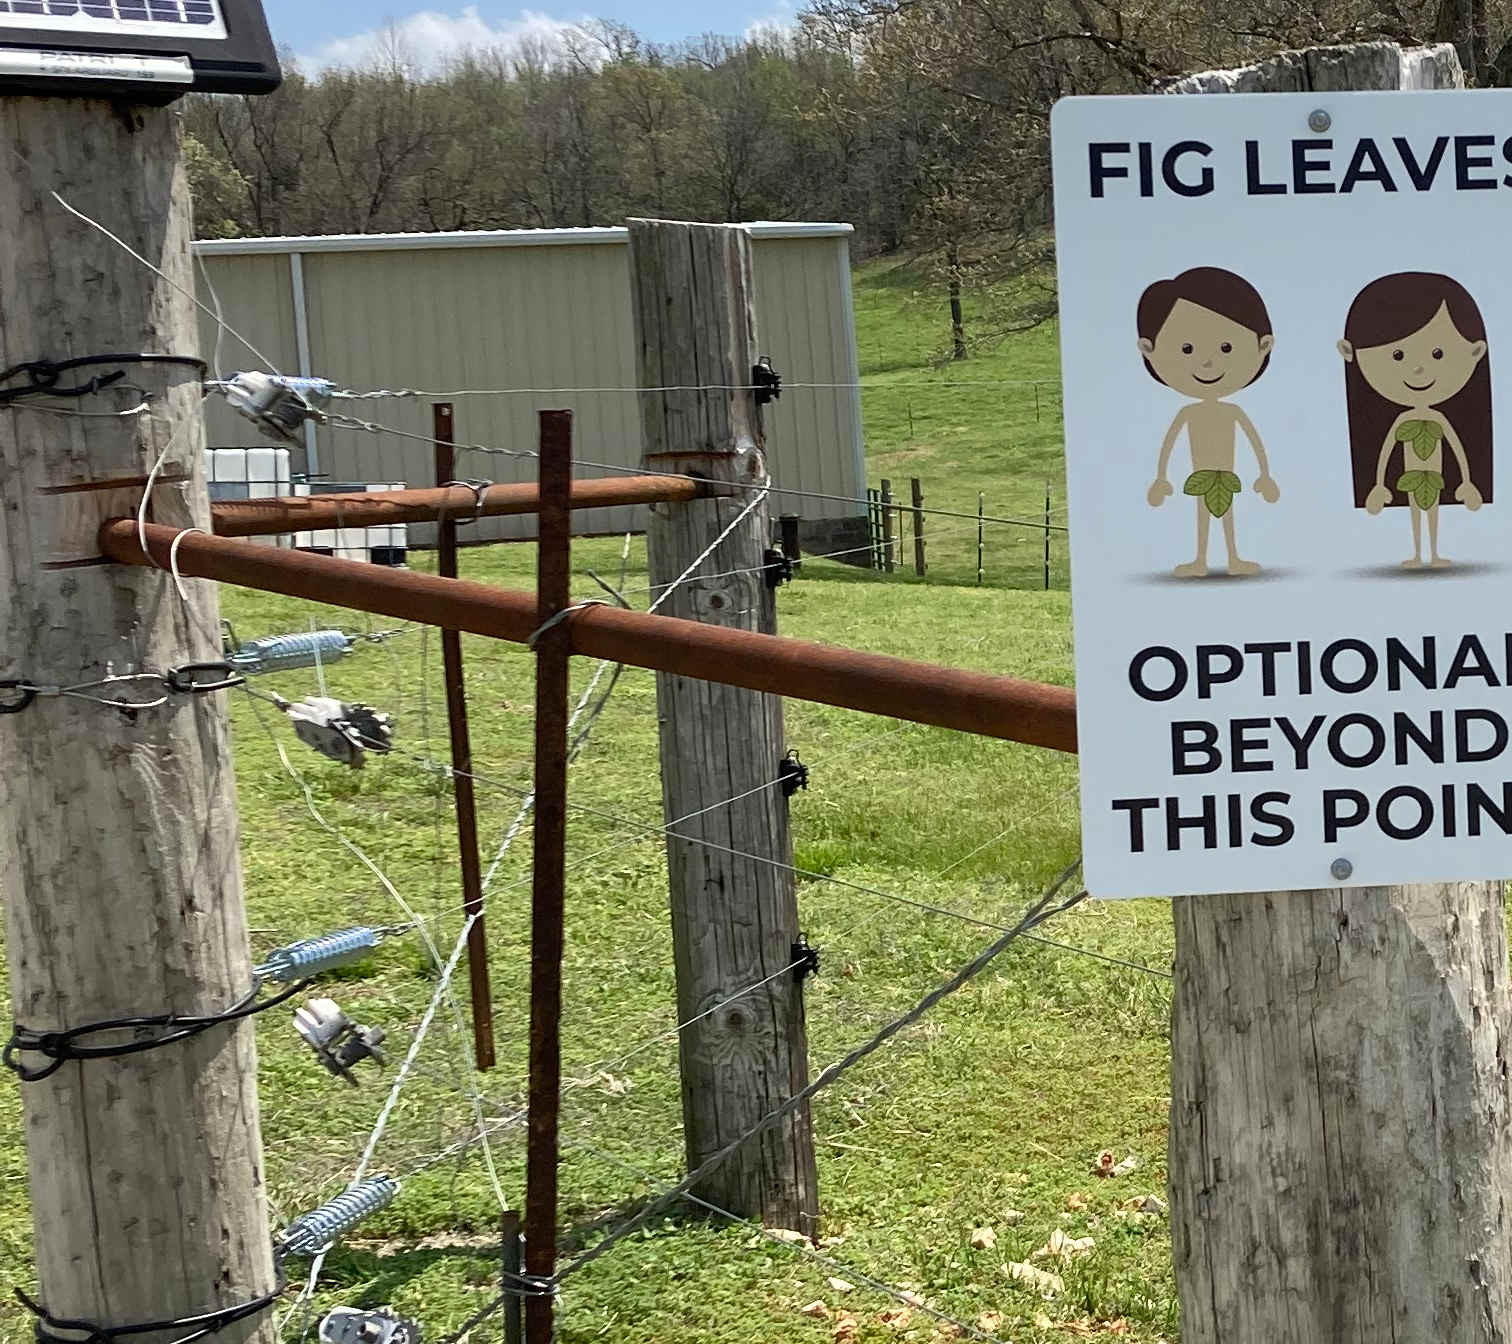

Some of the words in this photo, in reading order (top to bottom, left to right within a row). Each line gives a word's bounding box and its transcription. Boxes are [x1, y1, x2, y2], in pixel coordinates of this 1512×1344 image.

[1088, 141, 1215, 198] FIG
[1170, 708, 1509, 776] BEYOND
[1111, 791, 1295, 853] THIS
